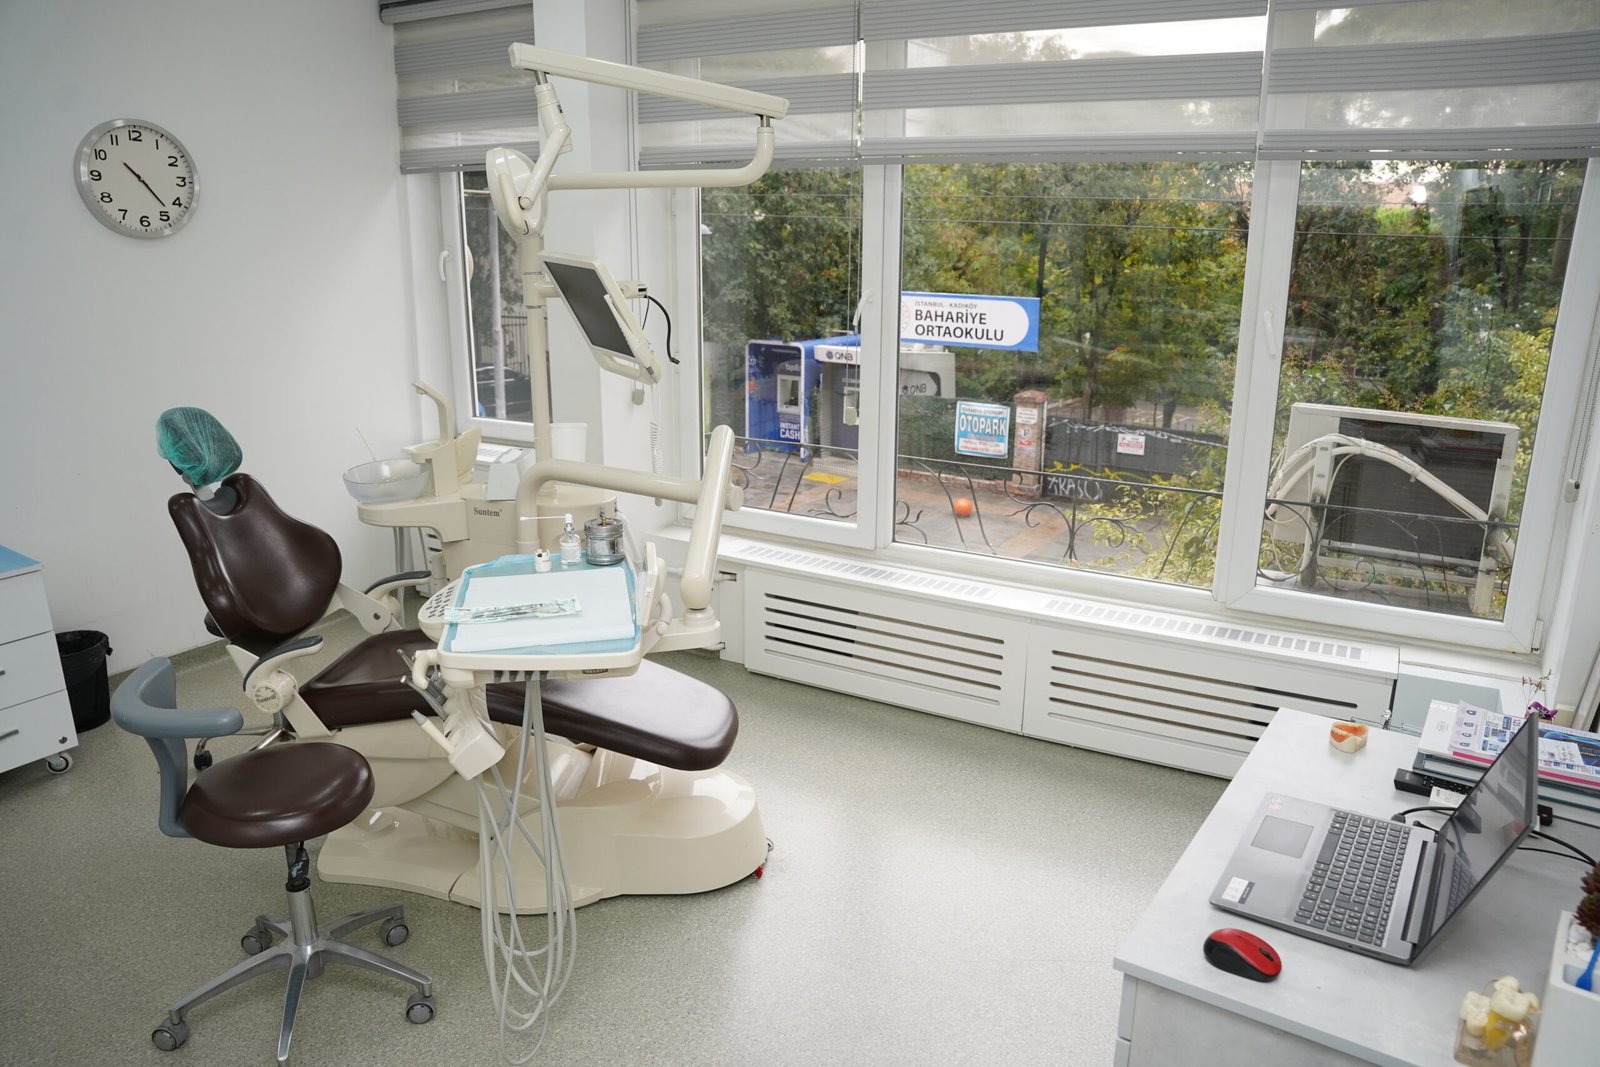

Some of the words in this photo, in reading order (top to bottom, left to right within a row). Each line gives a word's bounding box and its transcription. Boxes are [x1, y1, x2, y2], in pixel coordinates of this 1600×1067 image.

[110, 134, 119, 146] 11
[128, 130, 142, 142] 12
[94, 149, 107, 160] 10
[168, 156, 178, 167] 2
[90, 170, 102, 181] 9
[176, 176, 187, 187] 3
[101, 192, 113, 203] 8
[172, 197, 183, 208] 4
[118, 209, 128, 220] 7
[159, 211, 170, 222] 5
[140, 216, 151, 227] 6
[915, 309, 987, 325] BAHARİYE
[914, 324, 1004, 341] ORTAOKULU
[834, 351, 854, 361] QNB
[959, 414, 1007, 436] OTOPARK
[780, 428, 801, 440] CASH
